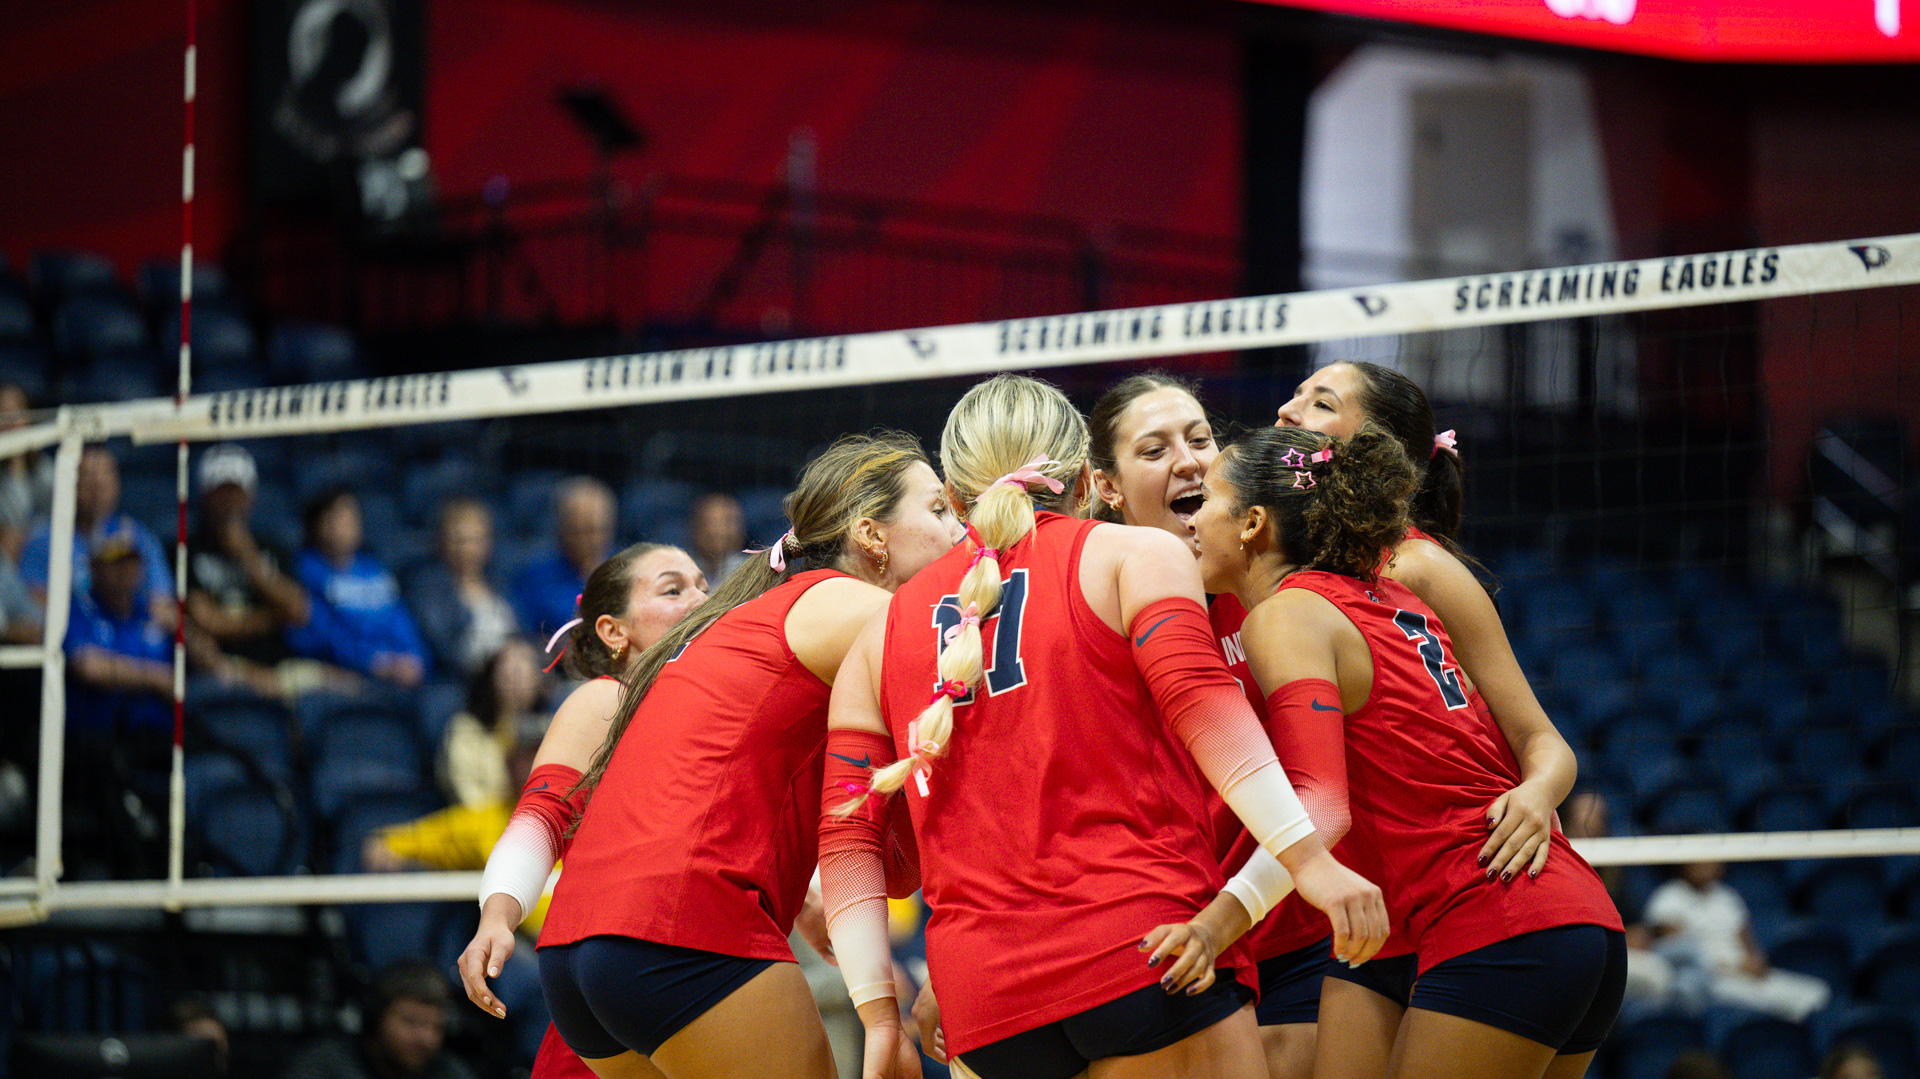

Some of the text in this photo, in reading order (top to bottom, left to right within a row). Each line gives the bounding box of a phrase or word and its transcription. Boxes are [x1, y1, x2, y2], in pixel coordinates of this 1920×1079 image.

[1454, 251, 1778, 312] SCREAMING EAGLES
[997, 297, 1288, 353] SCREAMING EAGLES
[1392, 608, 1469, 711] 2
